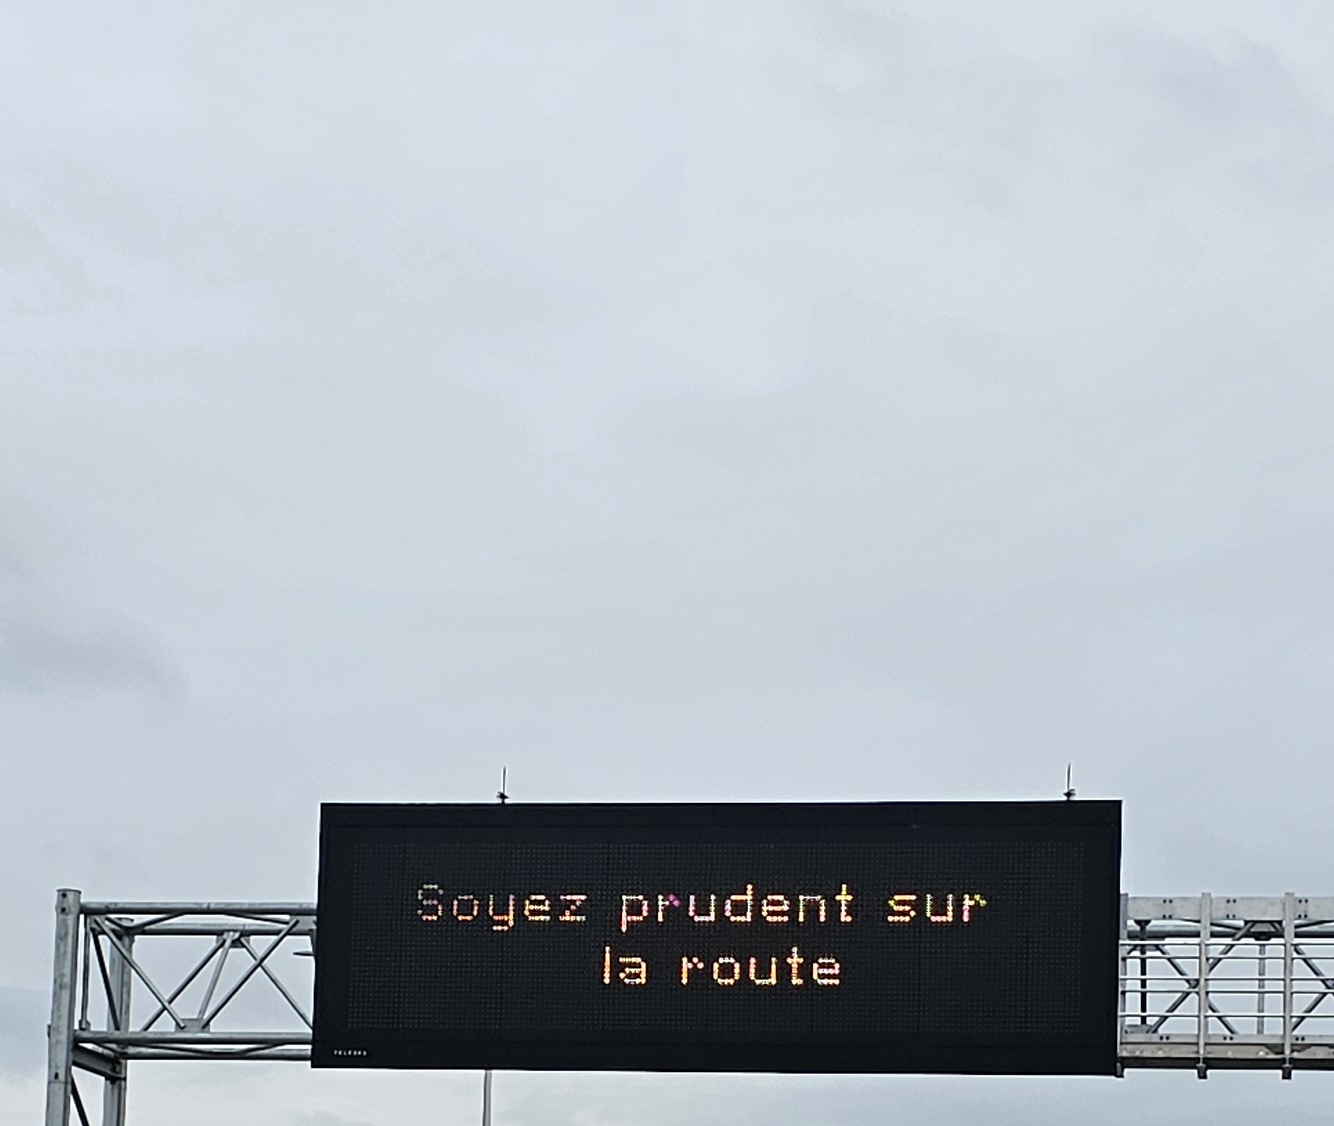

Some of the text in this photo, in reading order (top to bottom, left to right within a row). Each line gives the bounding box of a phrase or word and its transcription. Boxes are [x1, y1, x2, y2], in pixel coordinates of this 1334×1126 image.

[417, 884, 987, 933] Soyez prudent sur
[603, 946, 841, 986] la route
